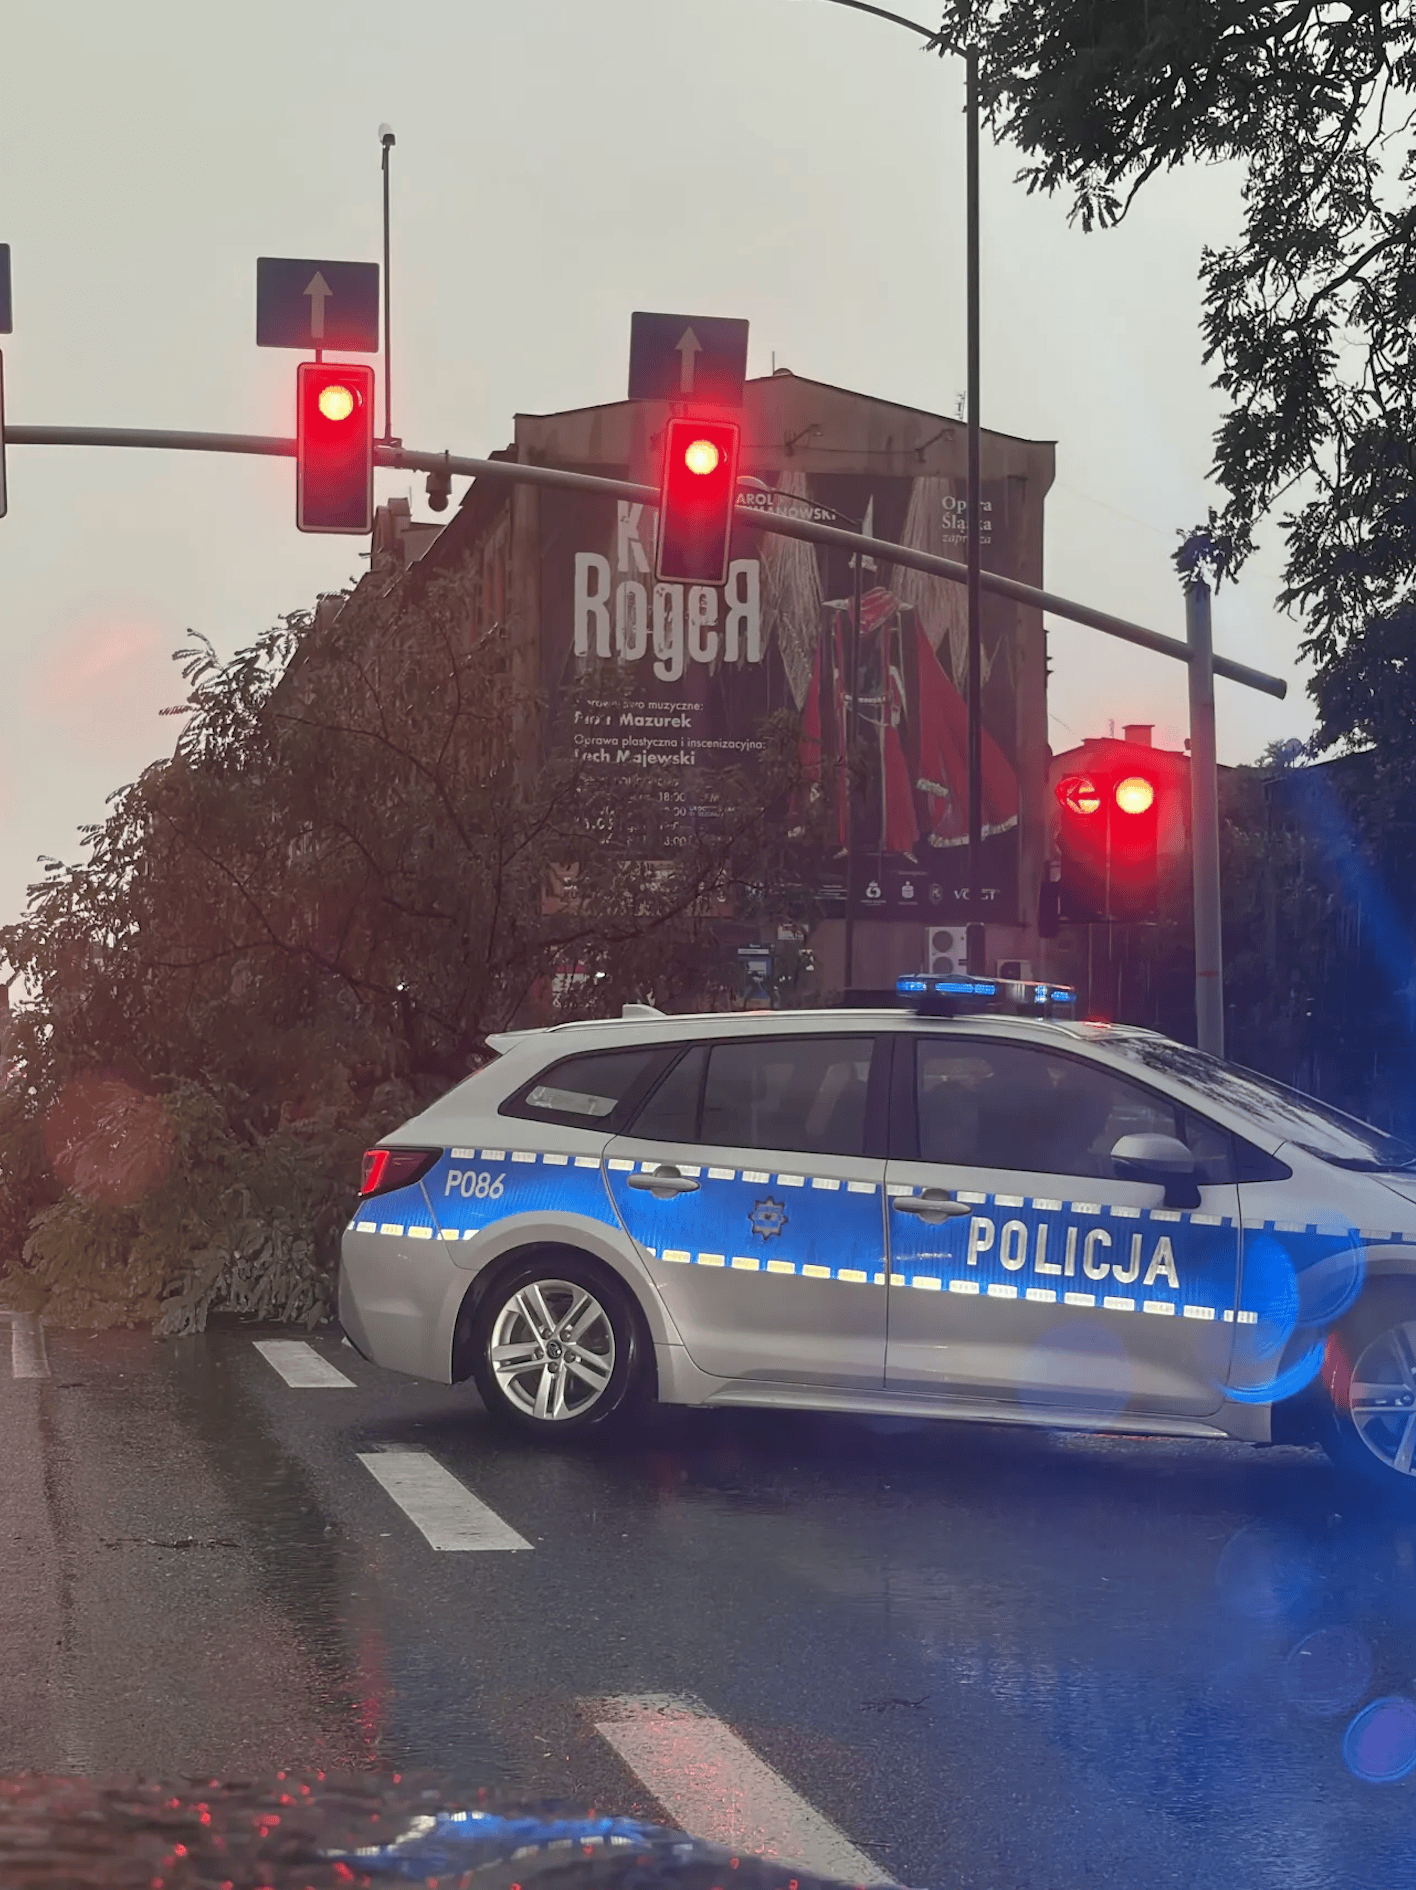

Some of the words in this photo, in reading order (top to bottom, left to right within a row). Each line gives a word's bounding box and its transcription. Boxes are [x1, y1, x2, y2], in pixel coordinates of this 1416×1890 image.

[736, 493, 773, 505] AROL
[942, 496, 992, 514] Opa
[942, 512, 992, 533] Śląa
[649, 701, 703, 713] muzyczne:
[620, 712, 692, 728] Mazurek
[574, 734, 619, 748] Oprawa
[622, 735, 678, 749] plastyczna
[444, 1169, 506, 1199] P086
[967, 1216, 1180, 1288] POLICJA
